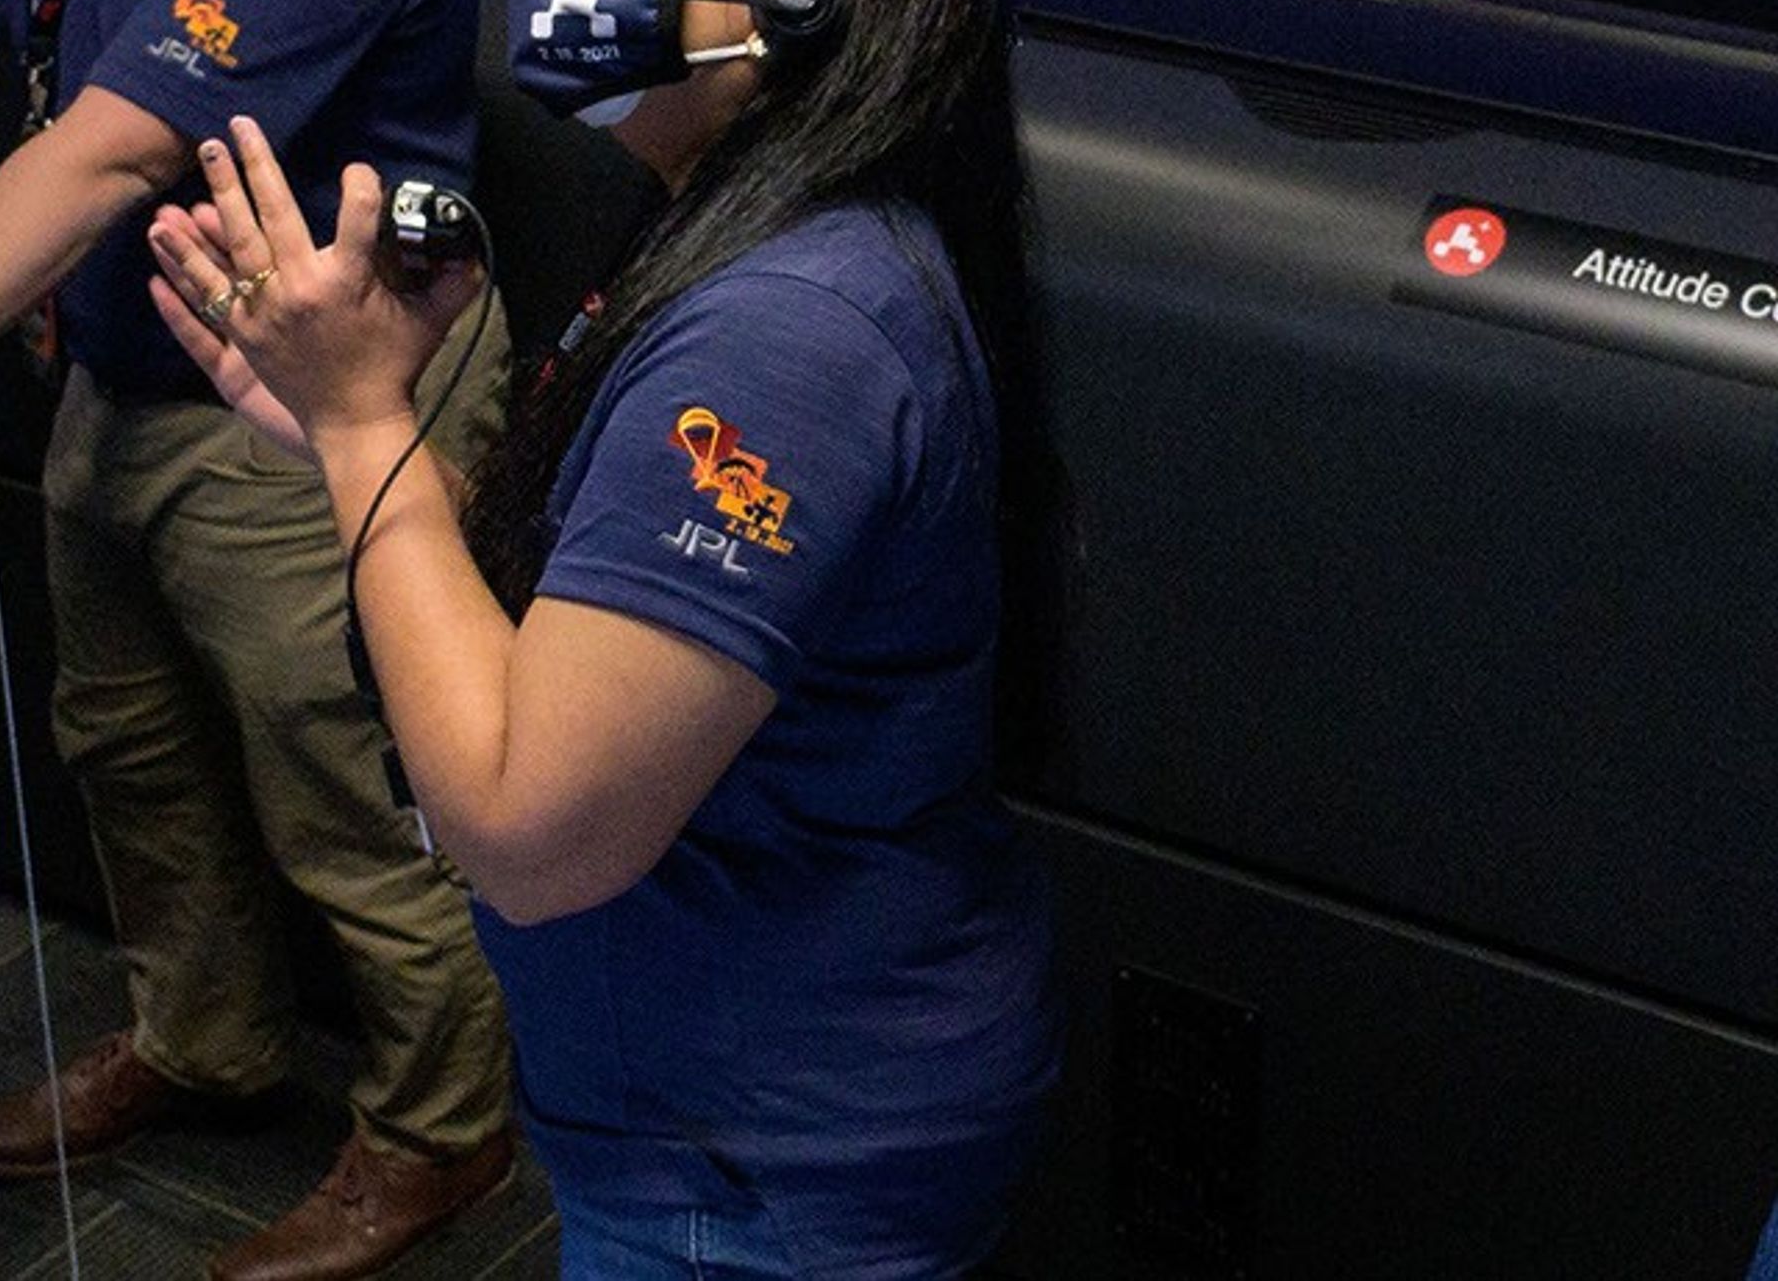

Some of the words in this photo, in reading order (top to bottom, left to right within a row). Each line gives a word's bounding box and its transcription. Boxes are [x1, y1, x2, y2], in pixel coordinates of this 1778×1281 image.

[146, 36, 204, 77] JPL
[1573, 248, 1730, 309] Attitude
[656, 518, 749, 574] JPL
